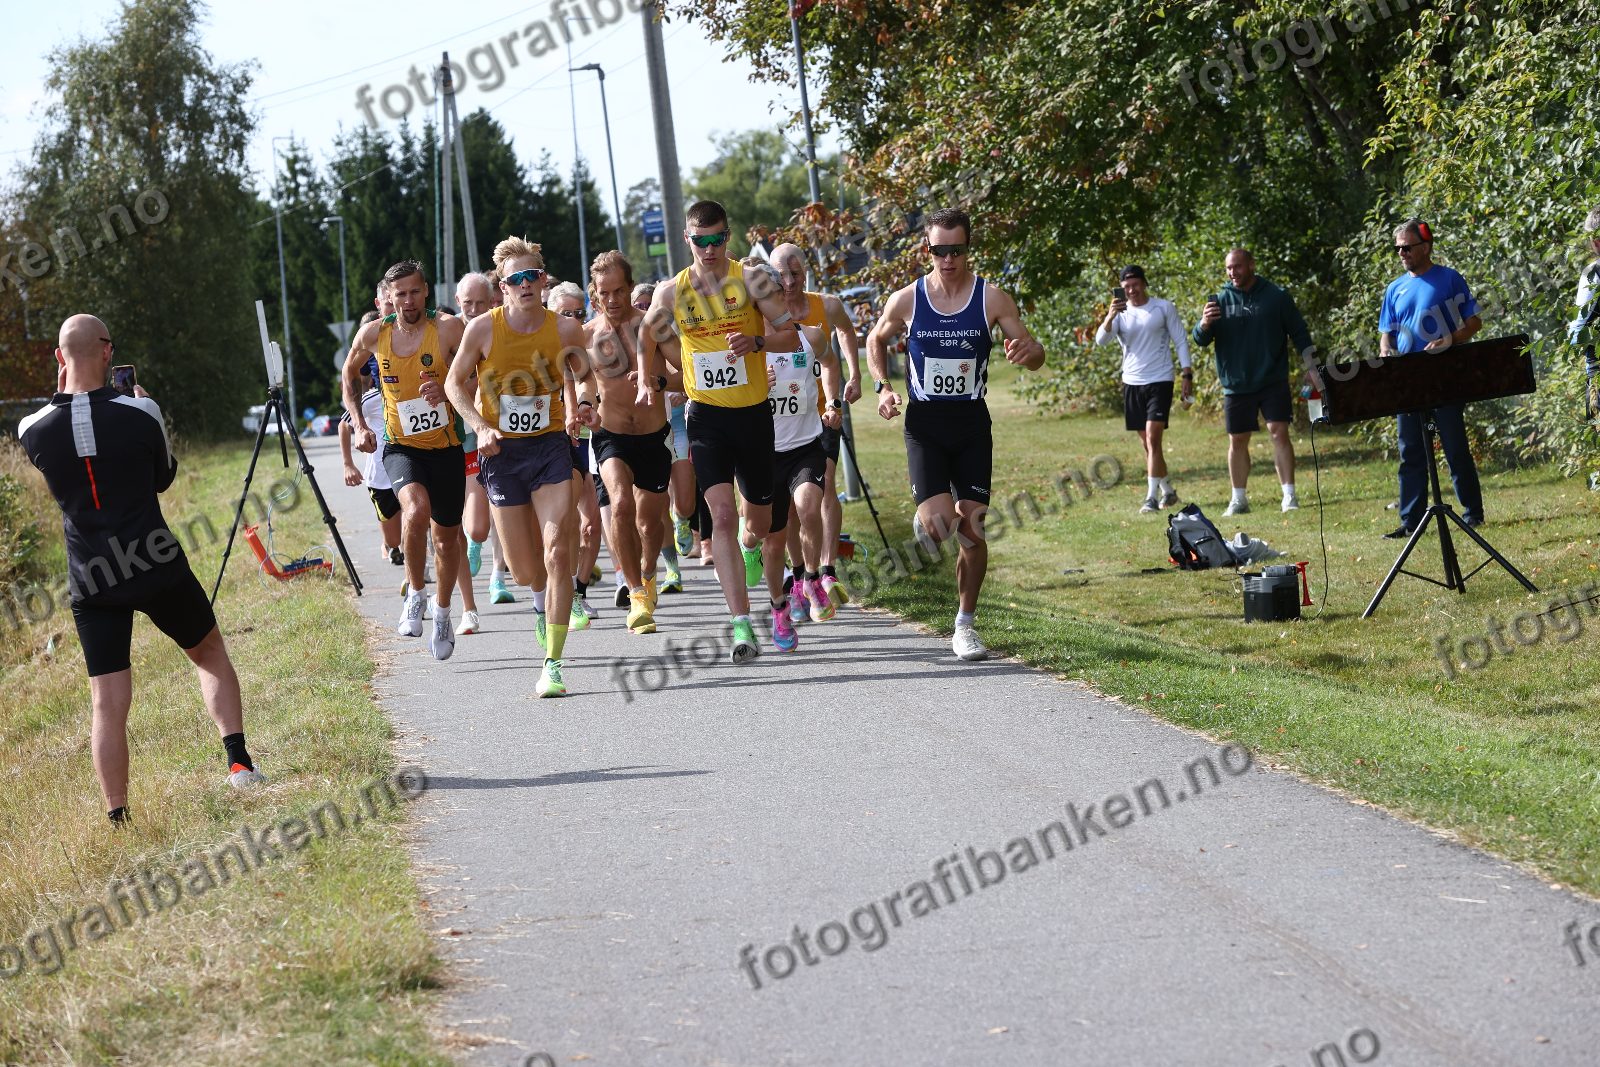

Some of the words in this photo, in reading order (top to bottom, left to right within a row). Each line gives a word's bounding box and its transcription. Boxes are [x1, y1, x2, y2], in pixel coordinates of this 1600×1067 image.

[916, 329, 981, 338] SPAREBANKEN
[940, 339, 958, 347] SØR
[703, 366, 738, 388] 942
[932, 374, 966, 394] 993
[769, 395, 799, 415] 976
[409, 410, 441, 433] 252
[508, 412, 541, 432] 992
[467, 461, 480, 469] TR
